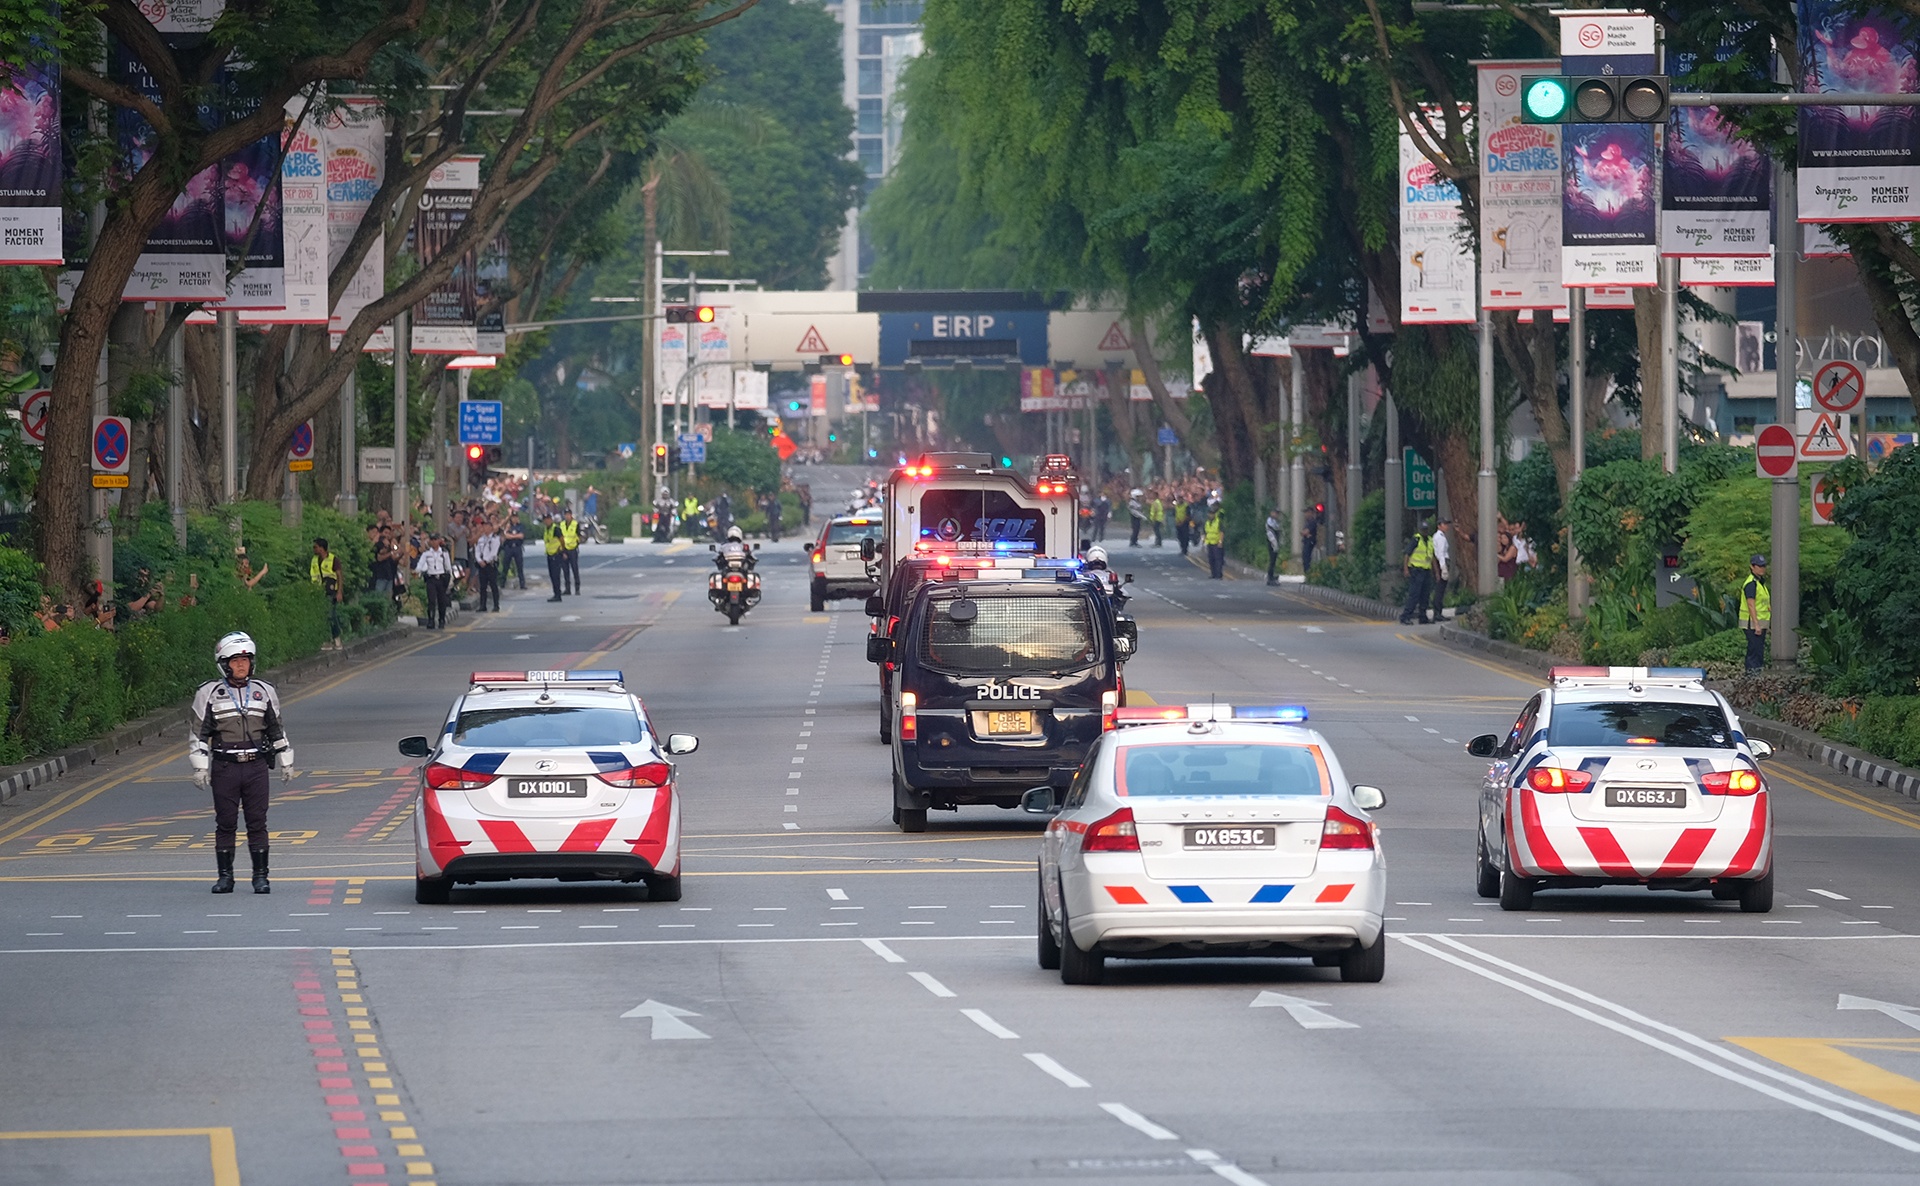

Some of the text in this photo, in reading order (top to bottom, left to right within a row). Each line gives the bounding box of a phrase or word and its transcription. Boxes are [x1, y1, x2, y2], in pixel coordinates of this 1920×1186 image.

[170, 14, 205, 23] Possibl
[1582, 30, 1600, 42] SG
[1498, 80, 1514, 91] SG
[1532, 147, 1556, 159] BIG
[1812, 148, 1912, 157] WWW.RAINFORESTLUMINA.SG
[1815, 185, 1851, 200] Singapore
[1871, 186, 1909, 195] MOMENT
[435, 195, 472, 203] ULTRA
[1837, 195, 1858, 209] Zoo
[1871, 195, 1909, 203] FACTORY
[5, 228, 44, 237] MOMENT
[1676, 225, 1707, 239] Singapore
[5, 237, 44, 245] FACTORY
[1695, 234, 1712, 246] Zoo
[131, 270, 162, 282] Singapore
[150, 277, 168, 289] Zoo
[932, 315, 995, 338] ERP
[808, 337, 818, 349] R
[971, 517, 1037, 538] SCDF
[960, 541, 993, 550] POLICE
[529, 670, 565, 682] POLICE
[977, 685, 1041, 700] POLICE
[1195, 829, 1264, 844] QX853C
